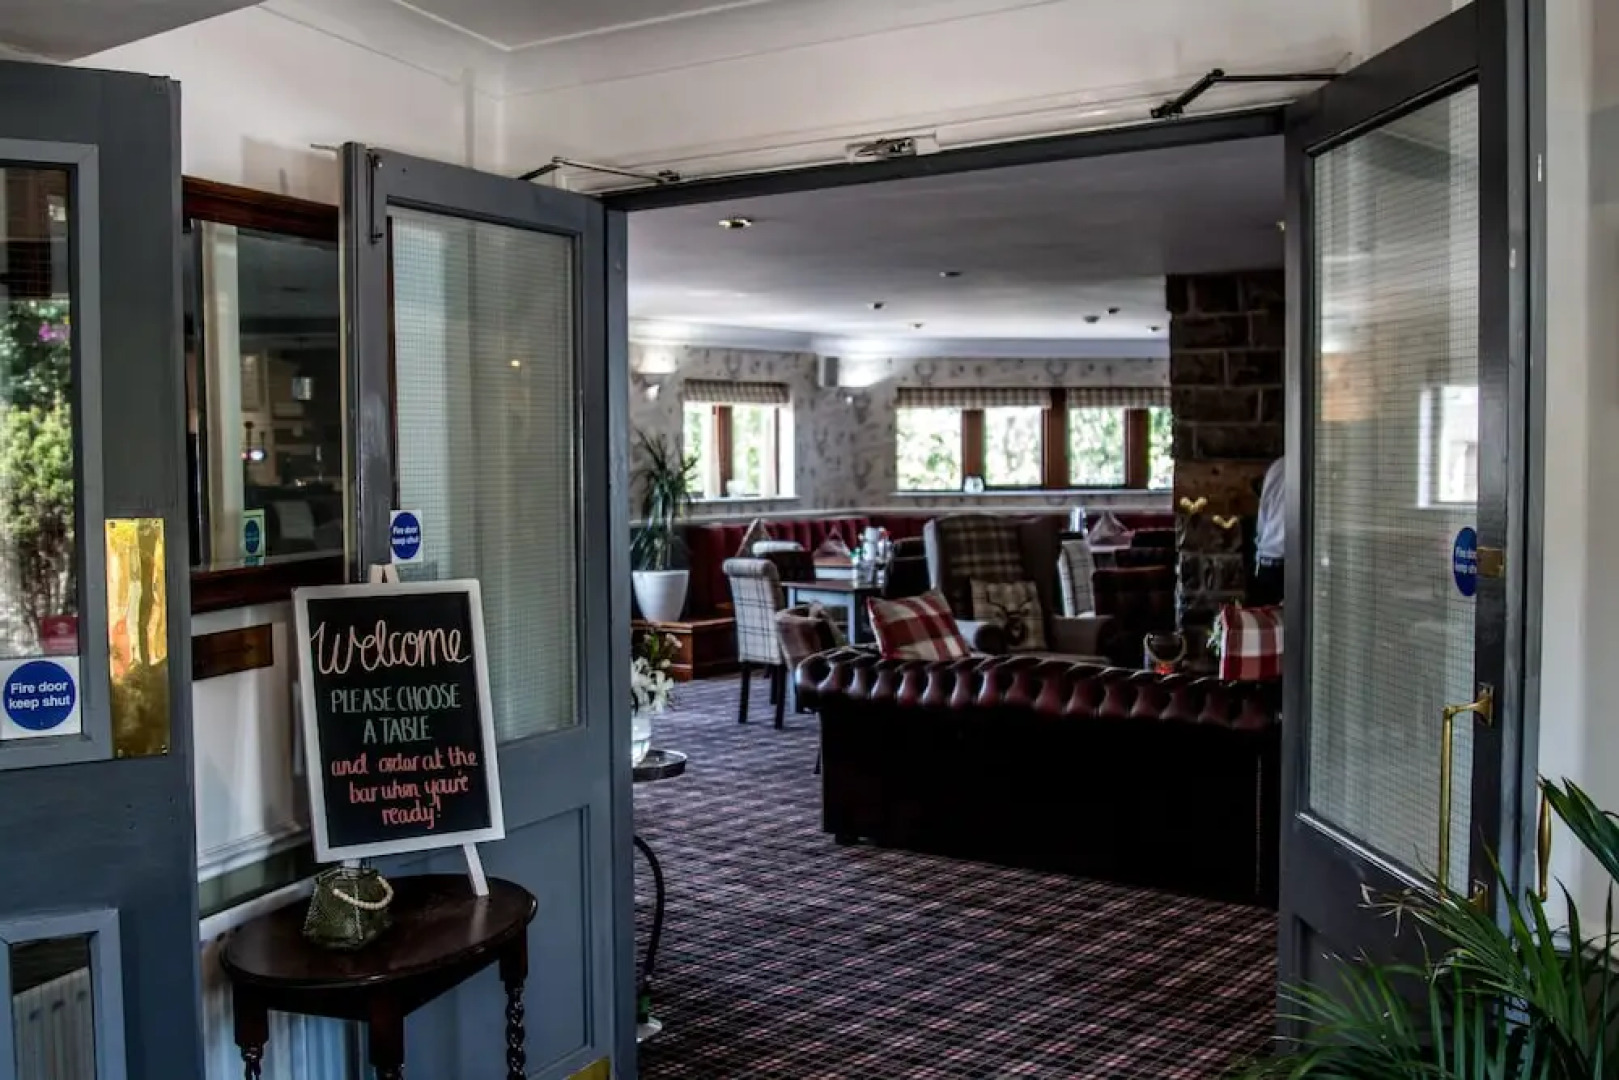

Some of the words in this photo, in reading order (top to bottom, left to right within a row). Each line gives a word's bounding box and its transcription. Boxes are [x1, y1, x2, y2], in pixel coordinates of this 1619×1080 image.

[311, 619, 471, 675] Welcome
[9, 697, 39, 711] keep
[42, 695, 71, 707] shut
[11, 682, 35, 695] Fire
[38, 681, 69, 692] door
[331, 686, 395, 714] PLEASE
[397, 683, 462, 711] CHOOSE
[363, 718, 377, 744] A
[380, 715, 432, 743] TABLE
[331, 752, 369, 777] and
[378, 752, 419, 773] order
[422, 747, 445, 771] at
[448, 746, 478, 767] the
[350, 781, 376, 804] bar
[381, 778, 421, 800] when
[424, 769, 469, 806] you're
[381, 795, 441, 830] ready!
